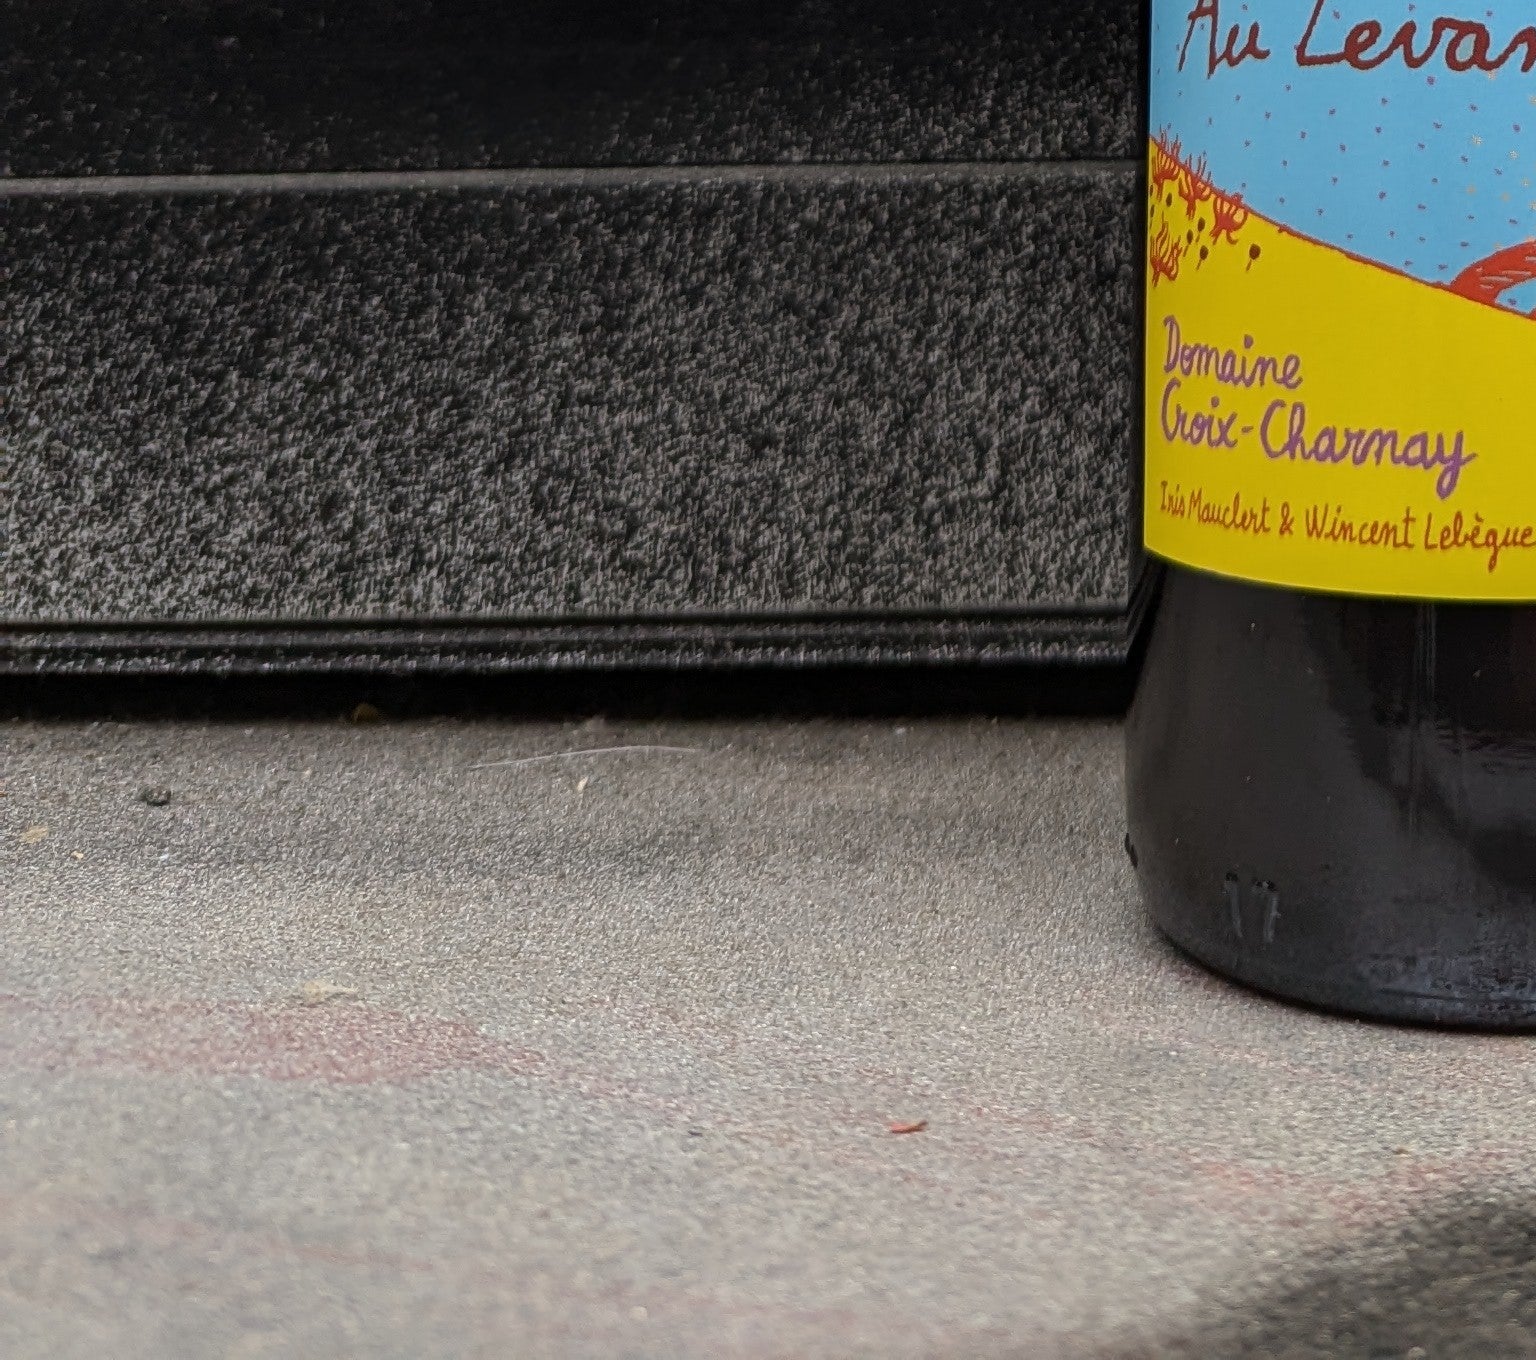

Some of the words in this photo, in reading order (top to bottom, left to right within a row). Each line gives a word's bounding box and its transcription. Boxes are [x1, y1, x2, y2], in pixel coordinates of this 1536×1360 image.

[1163, 314, 1304, 390] Domaine
[1160, 377, 1479, 501] Croix-Charnay
[1278, 501, 1296, 536] &
[1304, 503, 1415, 550] Wincent
